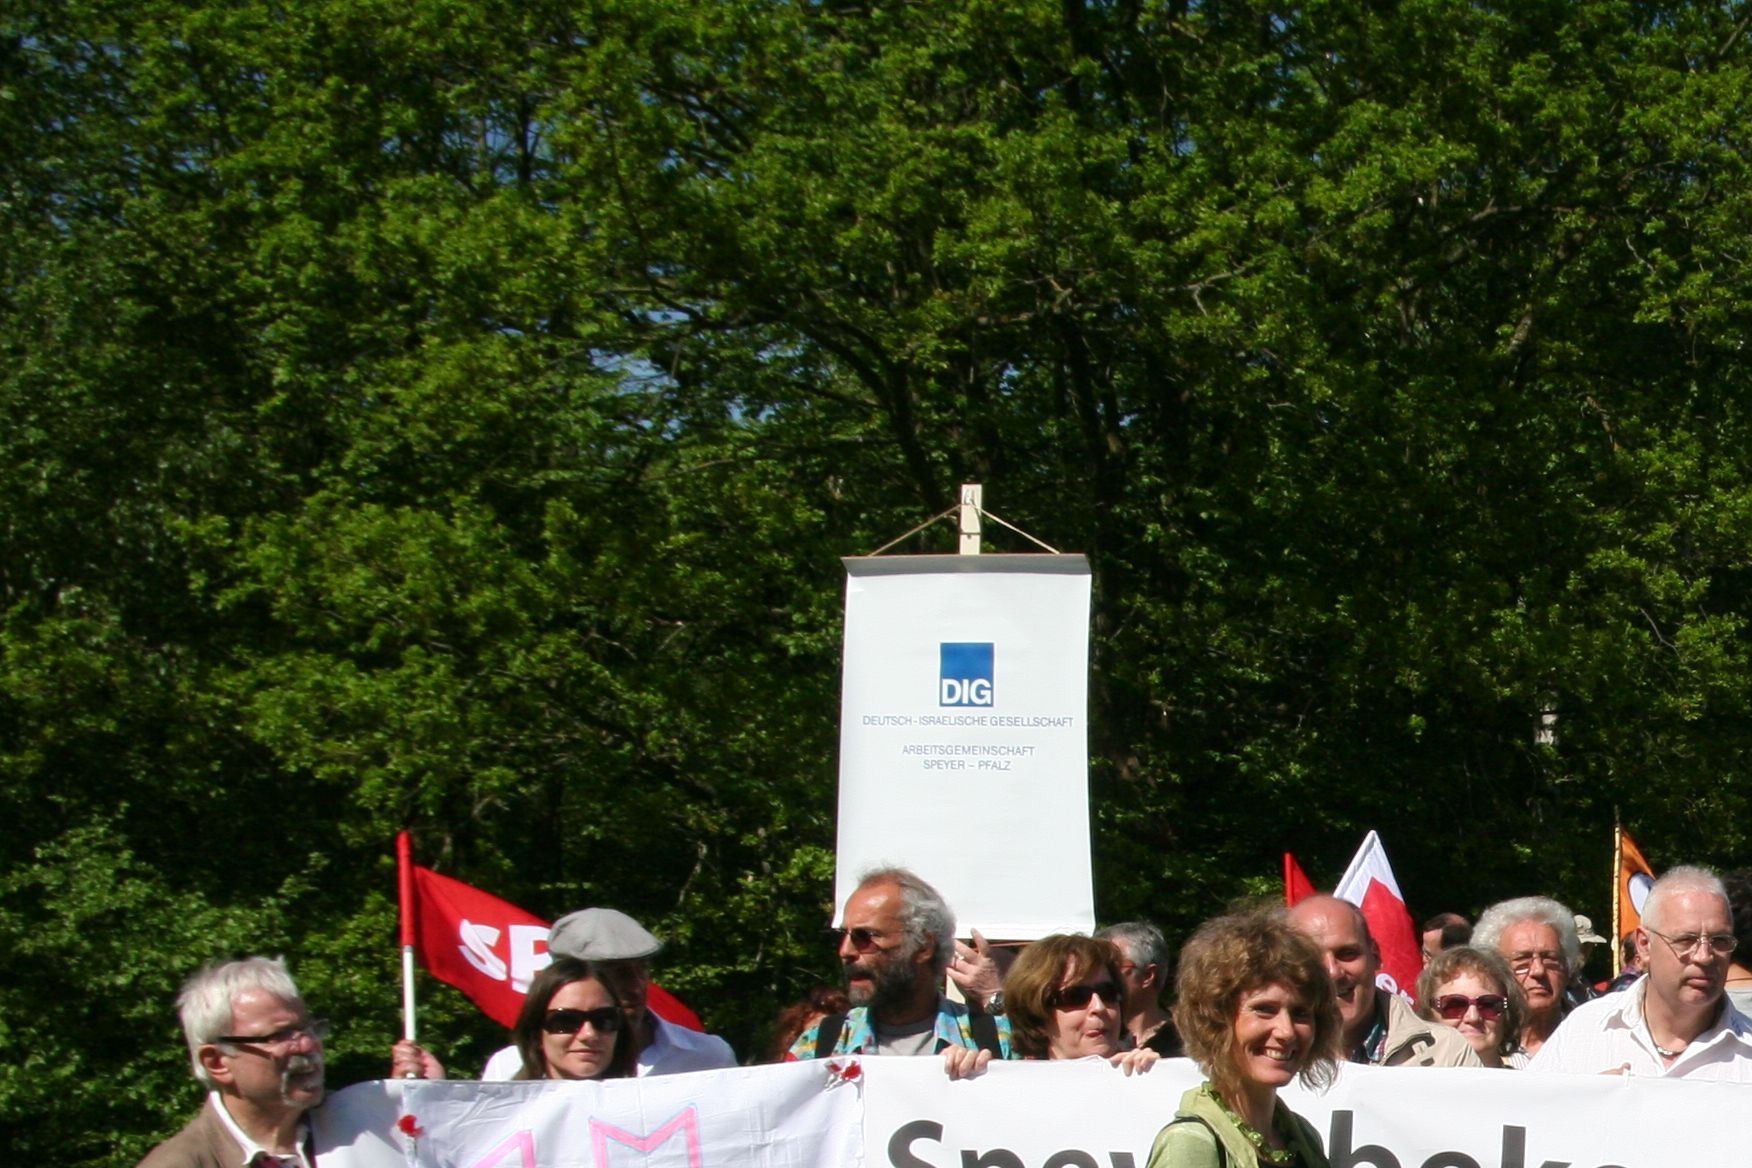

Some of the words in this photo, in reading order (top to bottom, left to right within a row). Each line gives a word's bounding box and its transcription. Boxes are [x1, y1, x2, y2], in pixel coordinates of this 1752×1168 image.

[942, 678, 992, 704] DIG
[990, 716, 1073, 727] GESELLSCHAFT
[902, 745, 1035, 756] ARBEITSGEMEINSCHAFT
[923, 760, 965, 770] SPEYER
[978, 760, 1011, 771] PFALZ
[458, 918, 554, 994] SP
